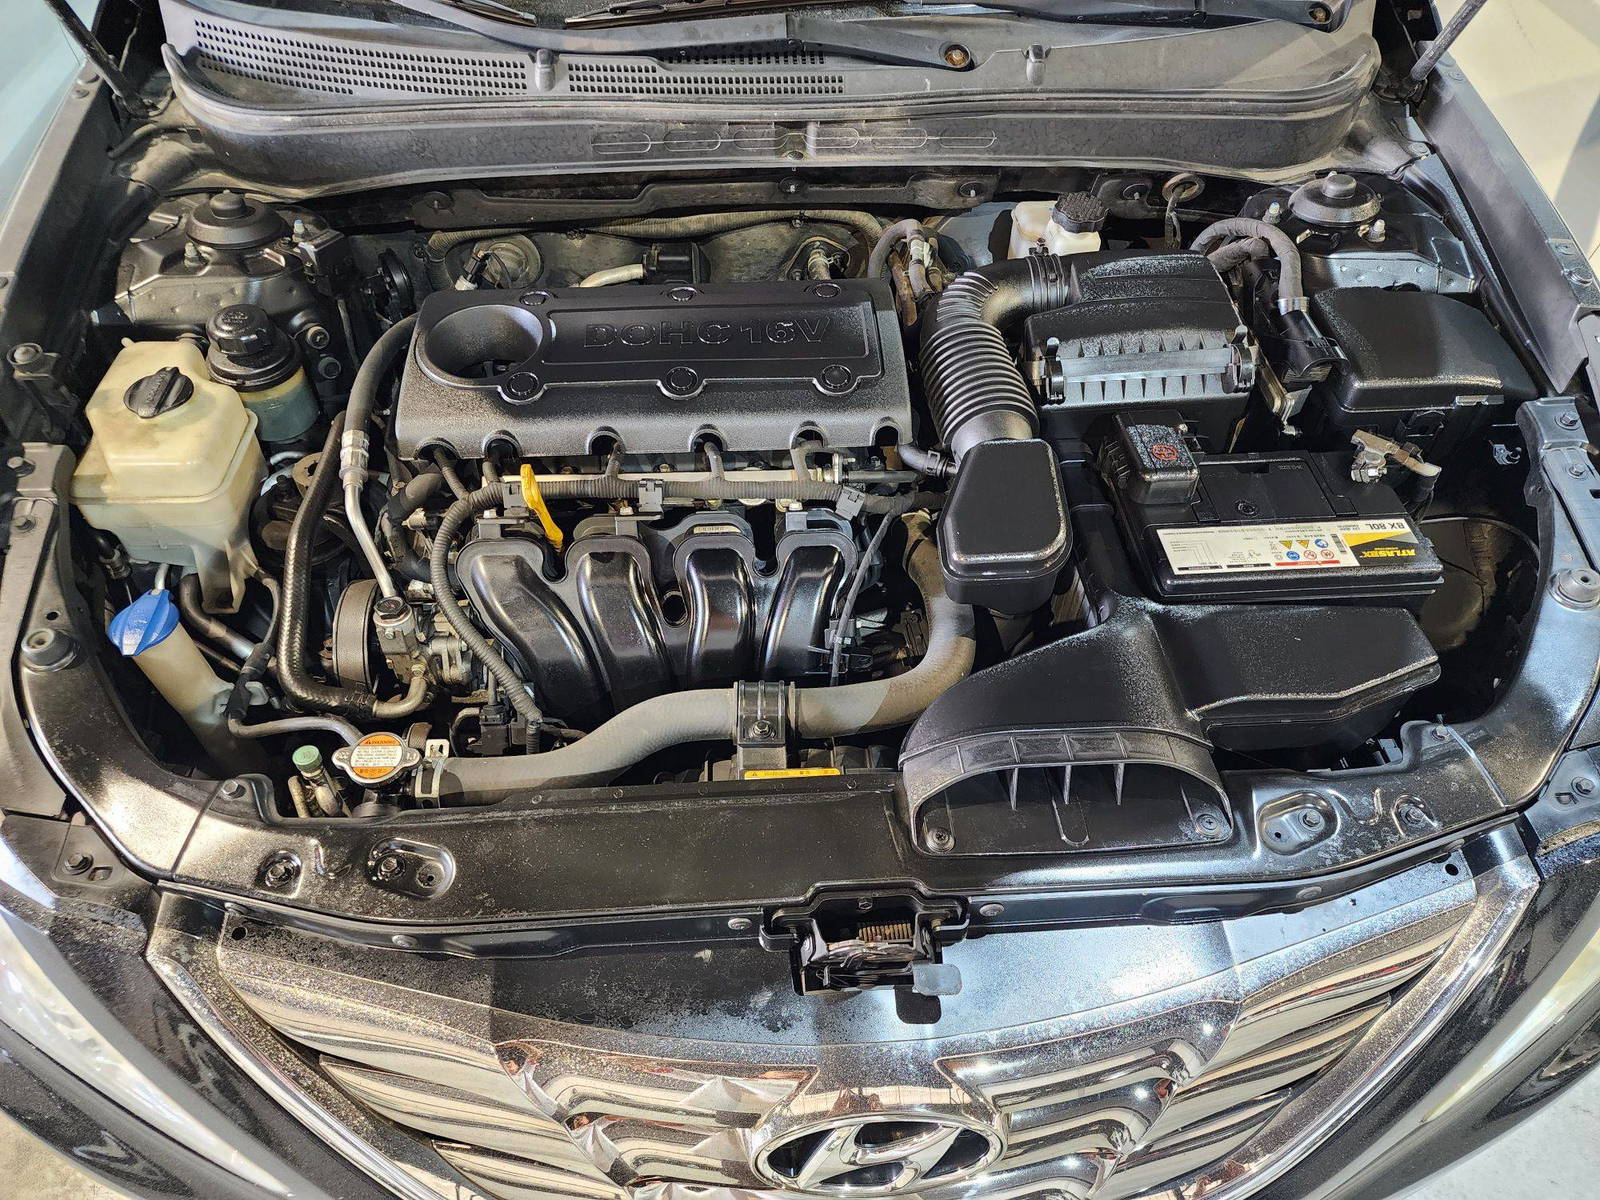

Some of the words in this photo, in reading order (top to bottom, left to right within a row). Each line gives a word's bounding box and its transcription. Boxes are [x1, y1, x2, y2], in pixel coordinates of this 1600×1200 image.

[584, 321, 731, 347] DOHC
[740, 316, 831, 344] 16V
[1361, 550, 1416, 558] ATLASBX
